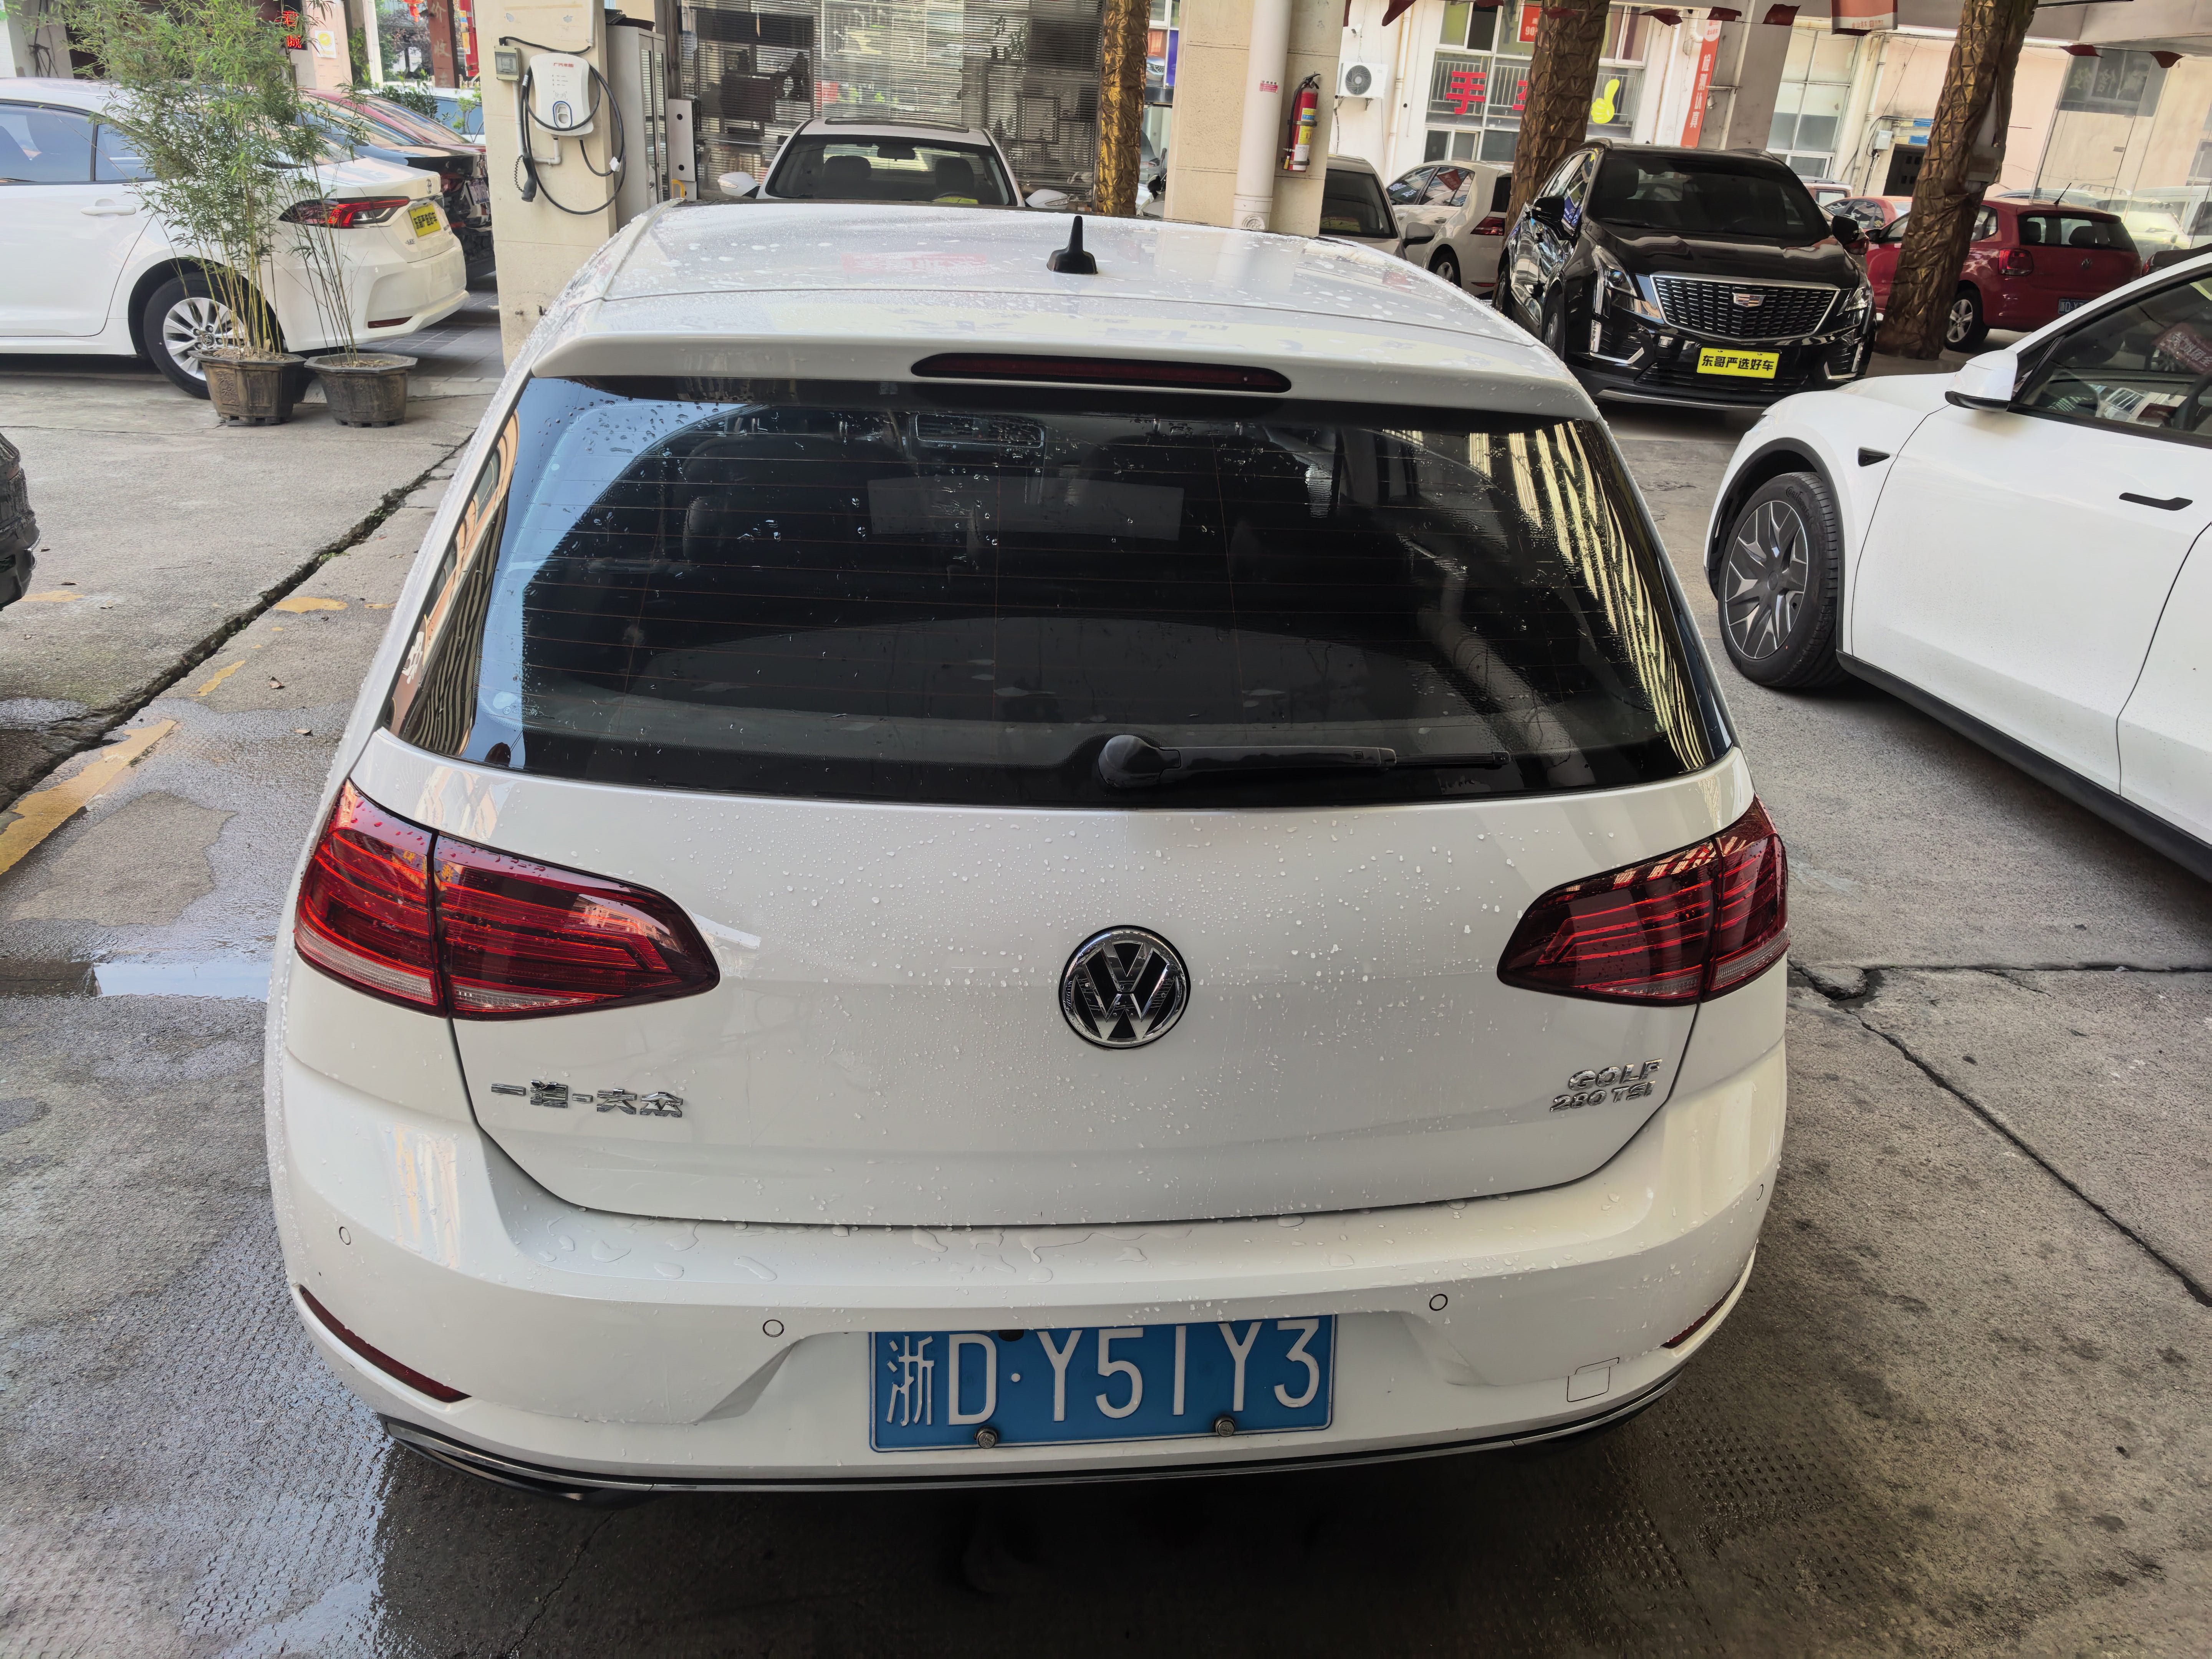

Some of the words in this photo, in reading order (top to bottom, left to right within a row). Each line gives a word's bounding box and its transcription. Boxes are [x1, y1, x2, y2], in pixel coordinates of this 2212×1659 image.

[1701, 355, 1775, 371] 东哥严选好车
[1568, 1058, 1663, 1091] GOLF
[1549, 1089, 1607, 1113] 280
[1611, 1080, 1656, 1103] TSI
[884, 1319, 1321, 1426] 浙D·Y51Y3
